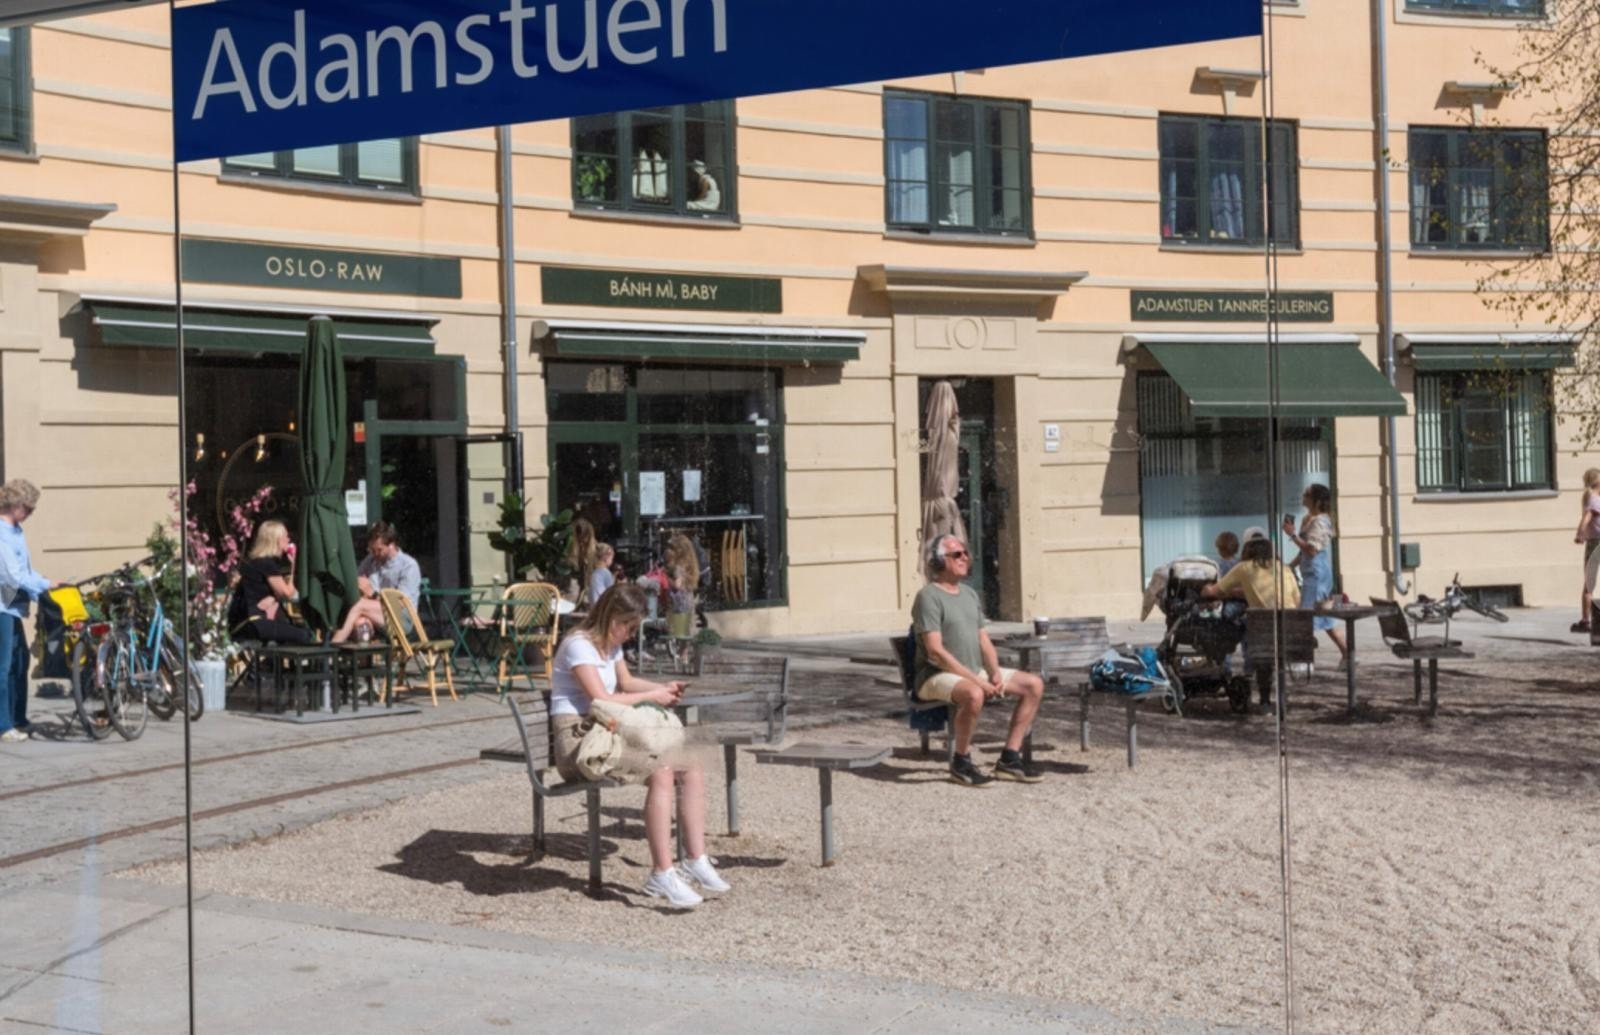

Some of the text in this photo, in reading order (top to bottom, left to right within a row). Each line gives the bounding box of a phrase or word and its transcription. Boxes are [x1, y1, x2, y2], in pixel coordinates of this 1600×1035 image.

[192, 0, 728, 120] Adamstuen
[609, 277, 652, 297] BÁNH
[681, 283, 718, 300] BABY
[1137, 298, 1329, 314] ADAMSTUEN TANNREGULERING
